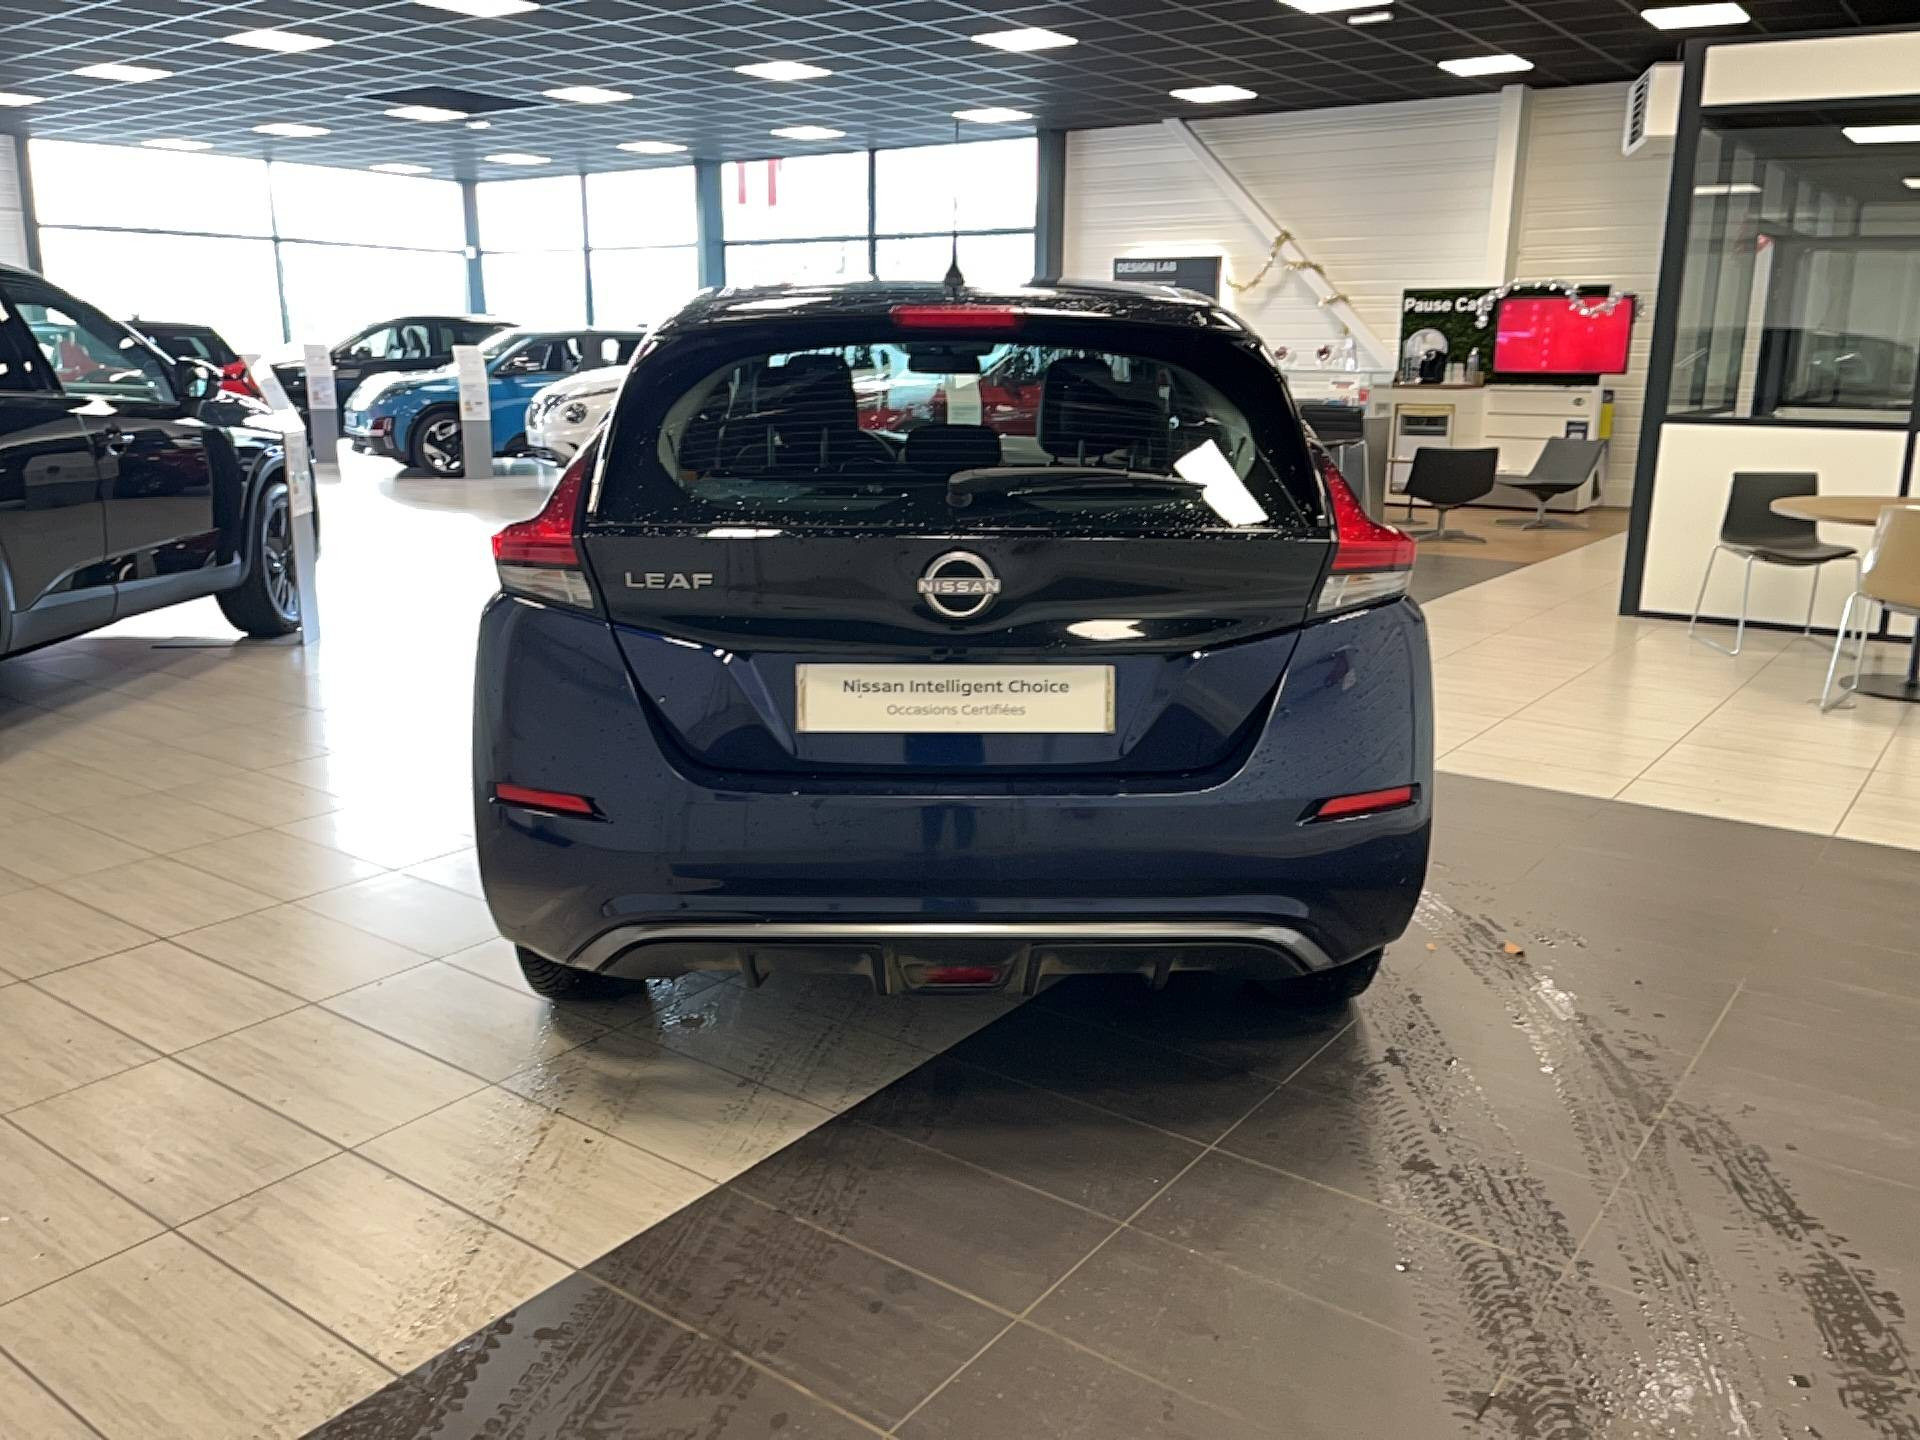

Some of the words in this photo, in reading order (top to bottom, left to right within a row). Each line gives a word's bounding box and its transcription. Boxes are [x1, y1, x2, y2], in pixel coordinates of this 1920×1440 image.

[1156, 261, 1177, 273] LAB
[1403, 297, 1453, 313] Pause
[1455, 297, 1494, 312] Ca
[624, 571, 713, 590] LEAF
[918, 580, 1001, 593] NISSAN
[843, 679, 904, 693] Nissan
[909, 679, 1004, 697] Intelligent
[1008, 679, 1069, 693] Choice
[886, 704, 958, 716] Occasions
[961, 703, 1026, 716] Certifiées
